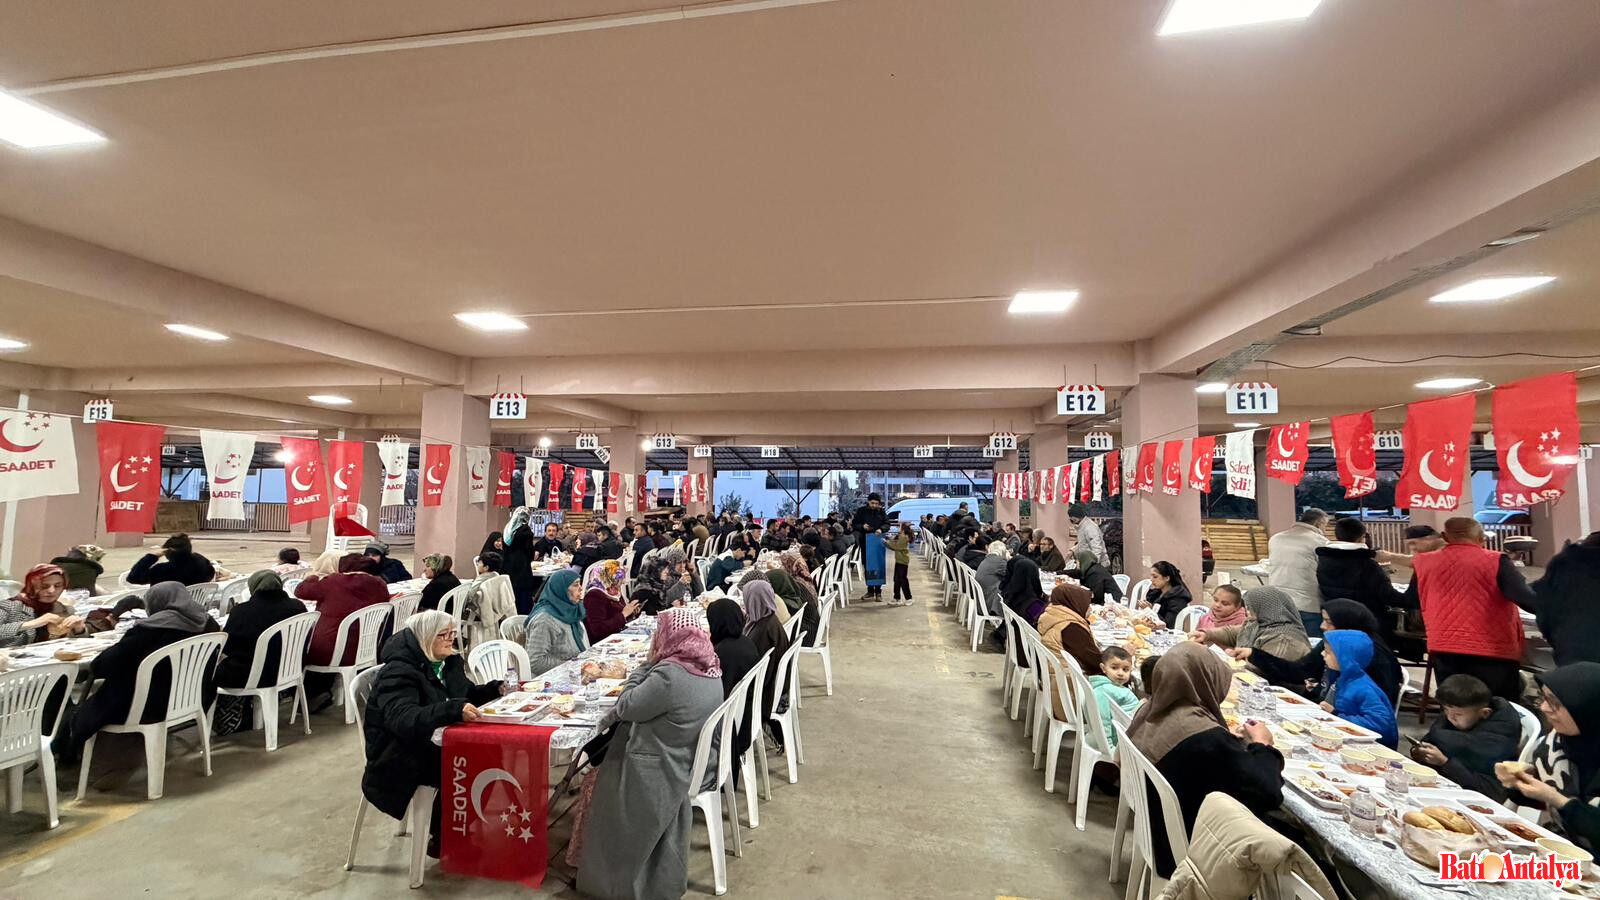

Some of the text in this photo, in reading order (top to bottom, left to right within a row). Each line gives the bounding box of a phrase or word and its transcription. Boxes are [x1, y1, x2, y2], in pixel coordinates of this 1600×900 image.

[1066, 394, 1096, 411] E12
[1237, 392, 1267, 409] E11
[496, 401, 520, 416] E13
[580, 438, 595, 448] G14
[656, 438, 672, 448] G13
[994, 438, 1013, 448] G12
[1090, 438, 1108, 448] G11
[1378, 436, 1400, 448] G10
[986, 448, 1000, 456] H16
[1270, 459, 1300, 472] SAADET
[452, 755, 468, 837] SAADET
